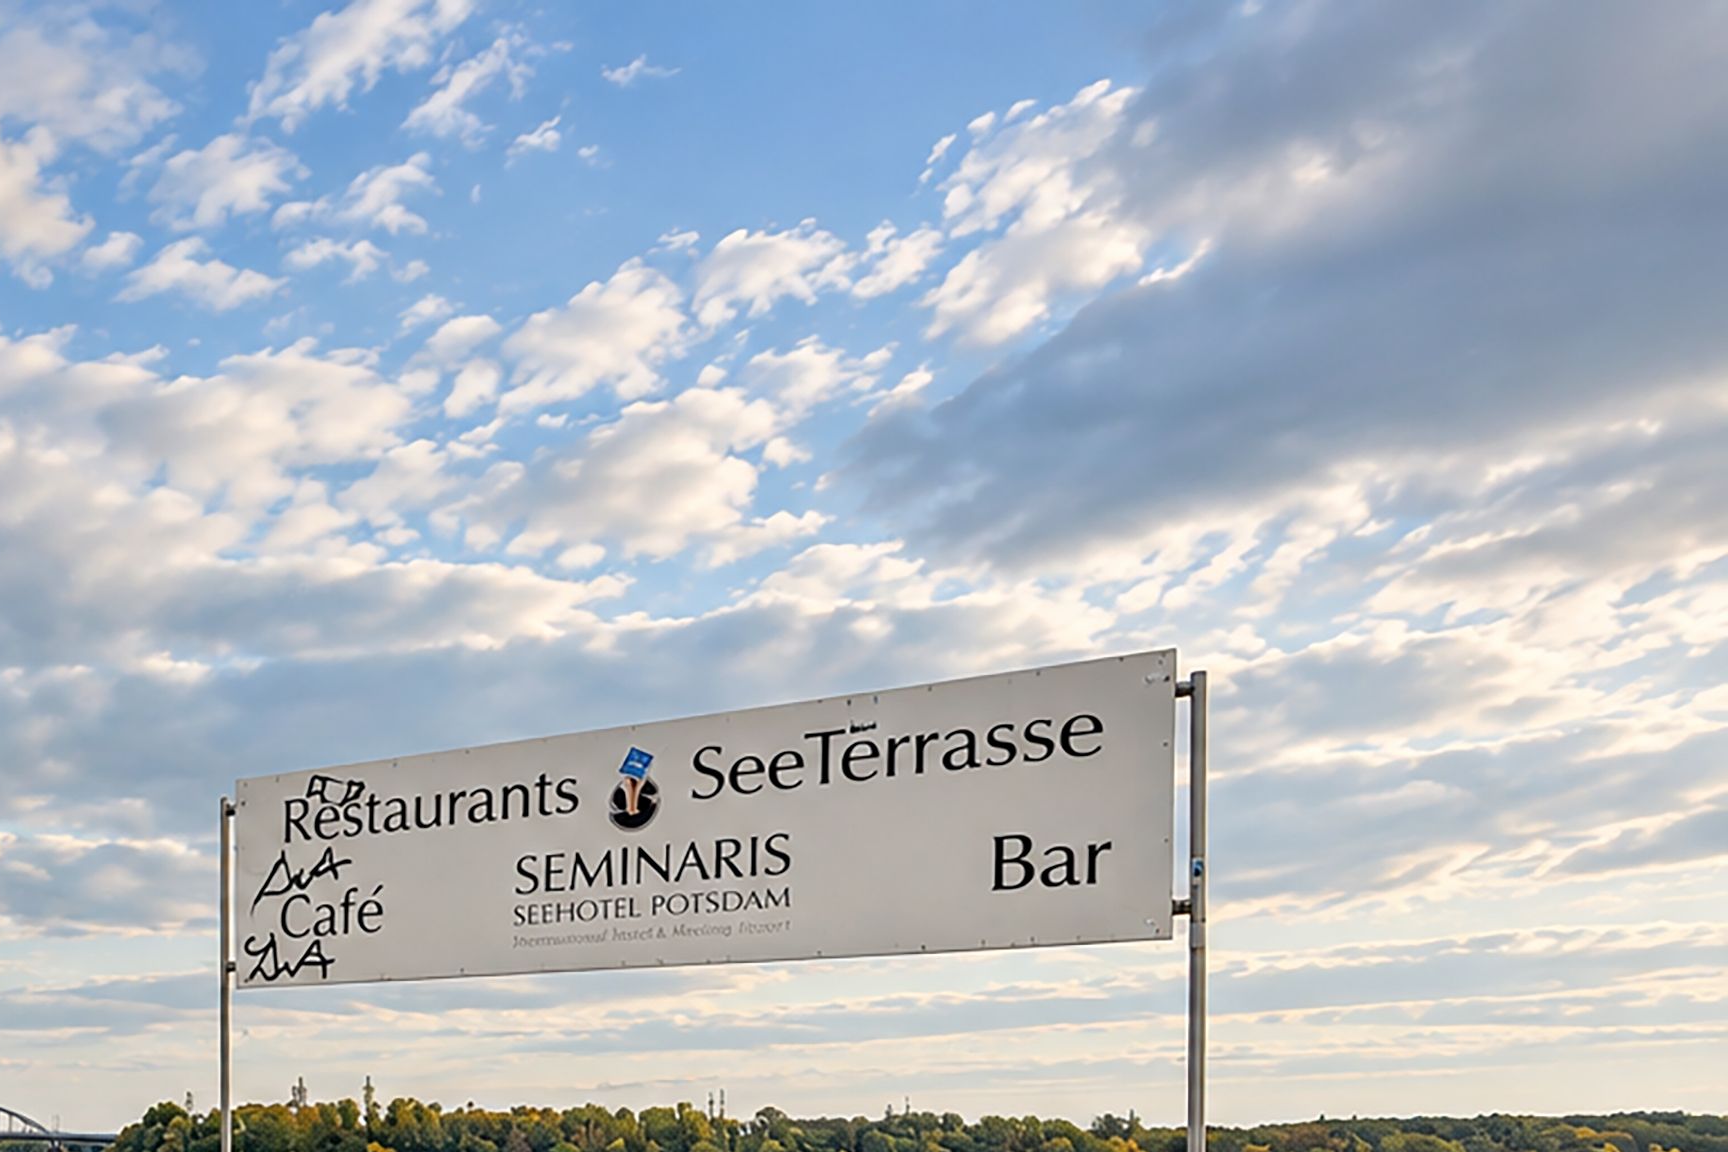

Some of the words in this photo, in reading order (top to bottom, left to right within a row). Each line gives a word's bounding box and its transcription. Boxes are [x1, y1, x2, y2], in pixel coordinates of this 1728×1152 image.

[284, 772, 580, 844] Restaurants
[514, 832, 792, 896] SEMINARIS
[990, 833, 1113, 892] Bar
[280, 884, 385, 939] Café
[512, 896, 642, 928] SEEHOTEL
[650, 886, 792, 917] POTSDAM
